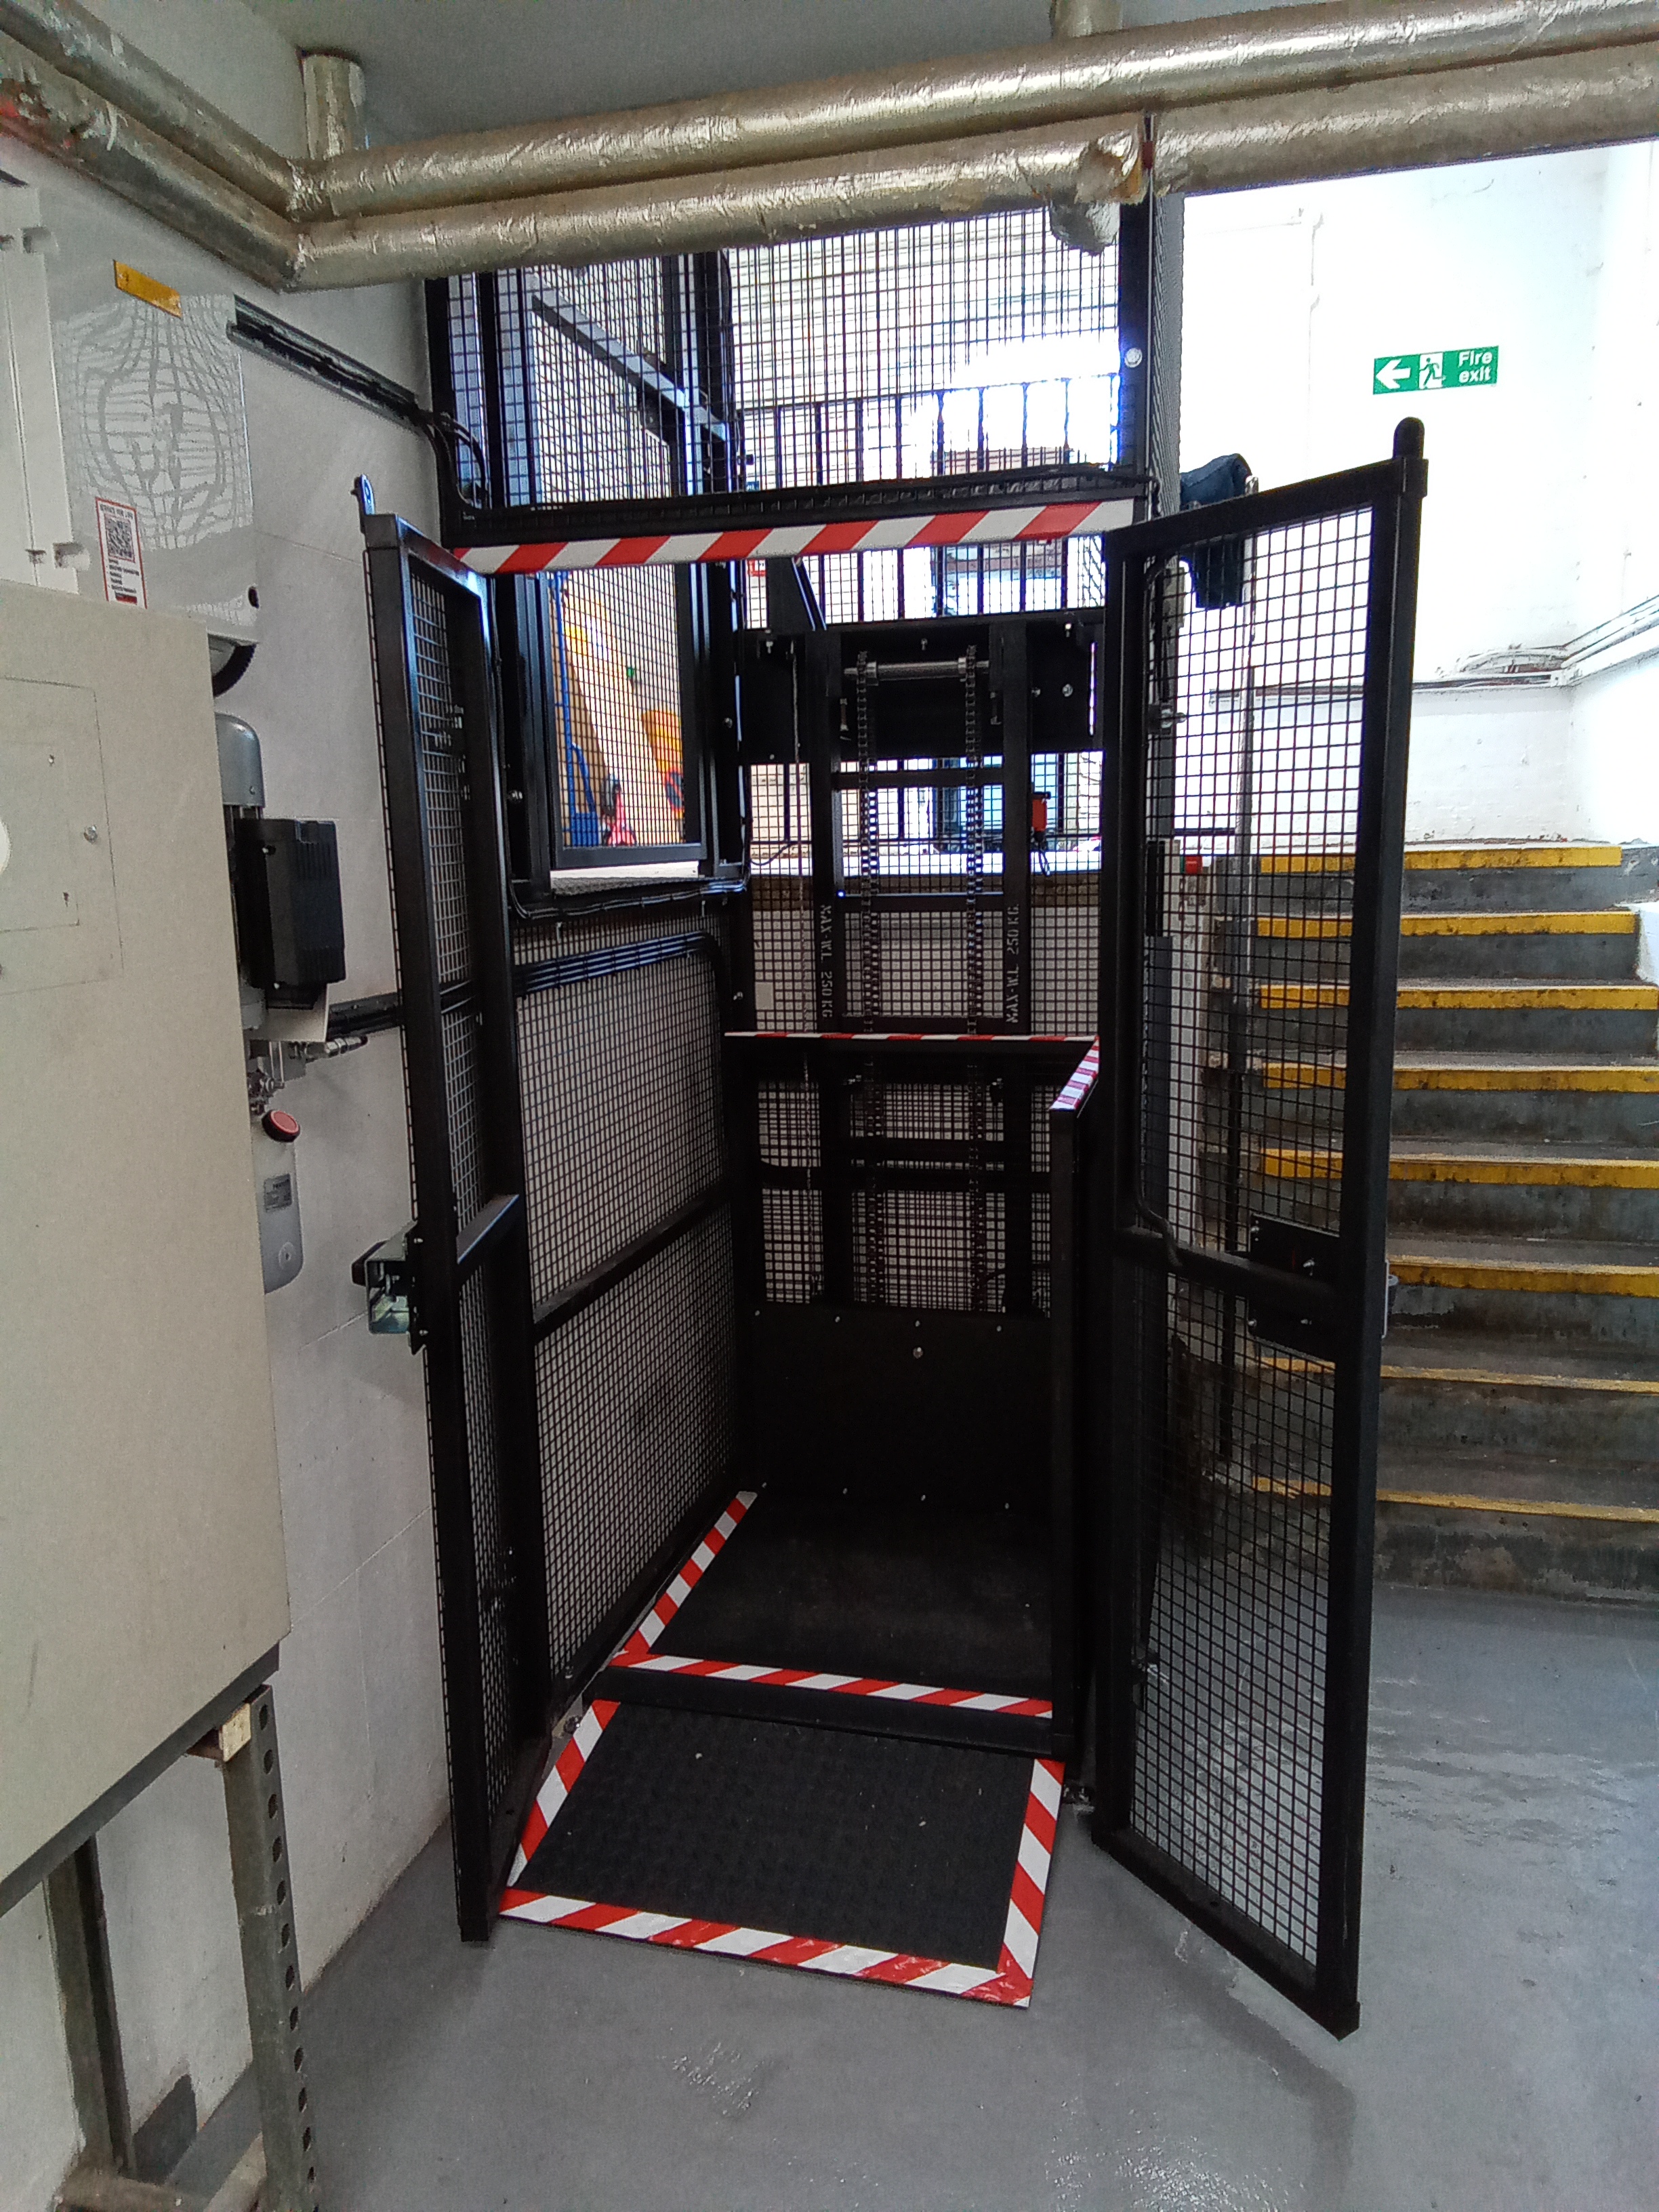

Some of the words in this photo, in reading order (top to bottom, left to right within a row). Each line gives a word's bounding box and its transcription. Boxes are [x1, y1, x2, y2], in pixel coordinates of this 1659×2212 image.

[1458, 350, 1493, 368] Fire
[1458, 365, 1492, 383] exit
[1006, 929, 1019, 955] 250
[821, 970, 833, 996] 250
